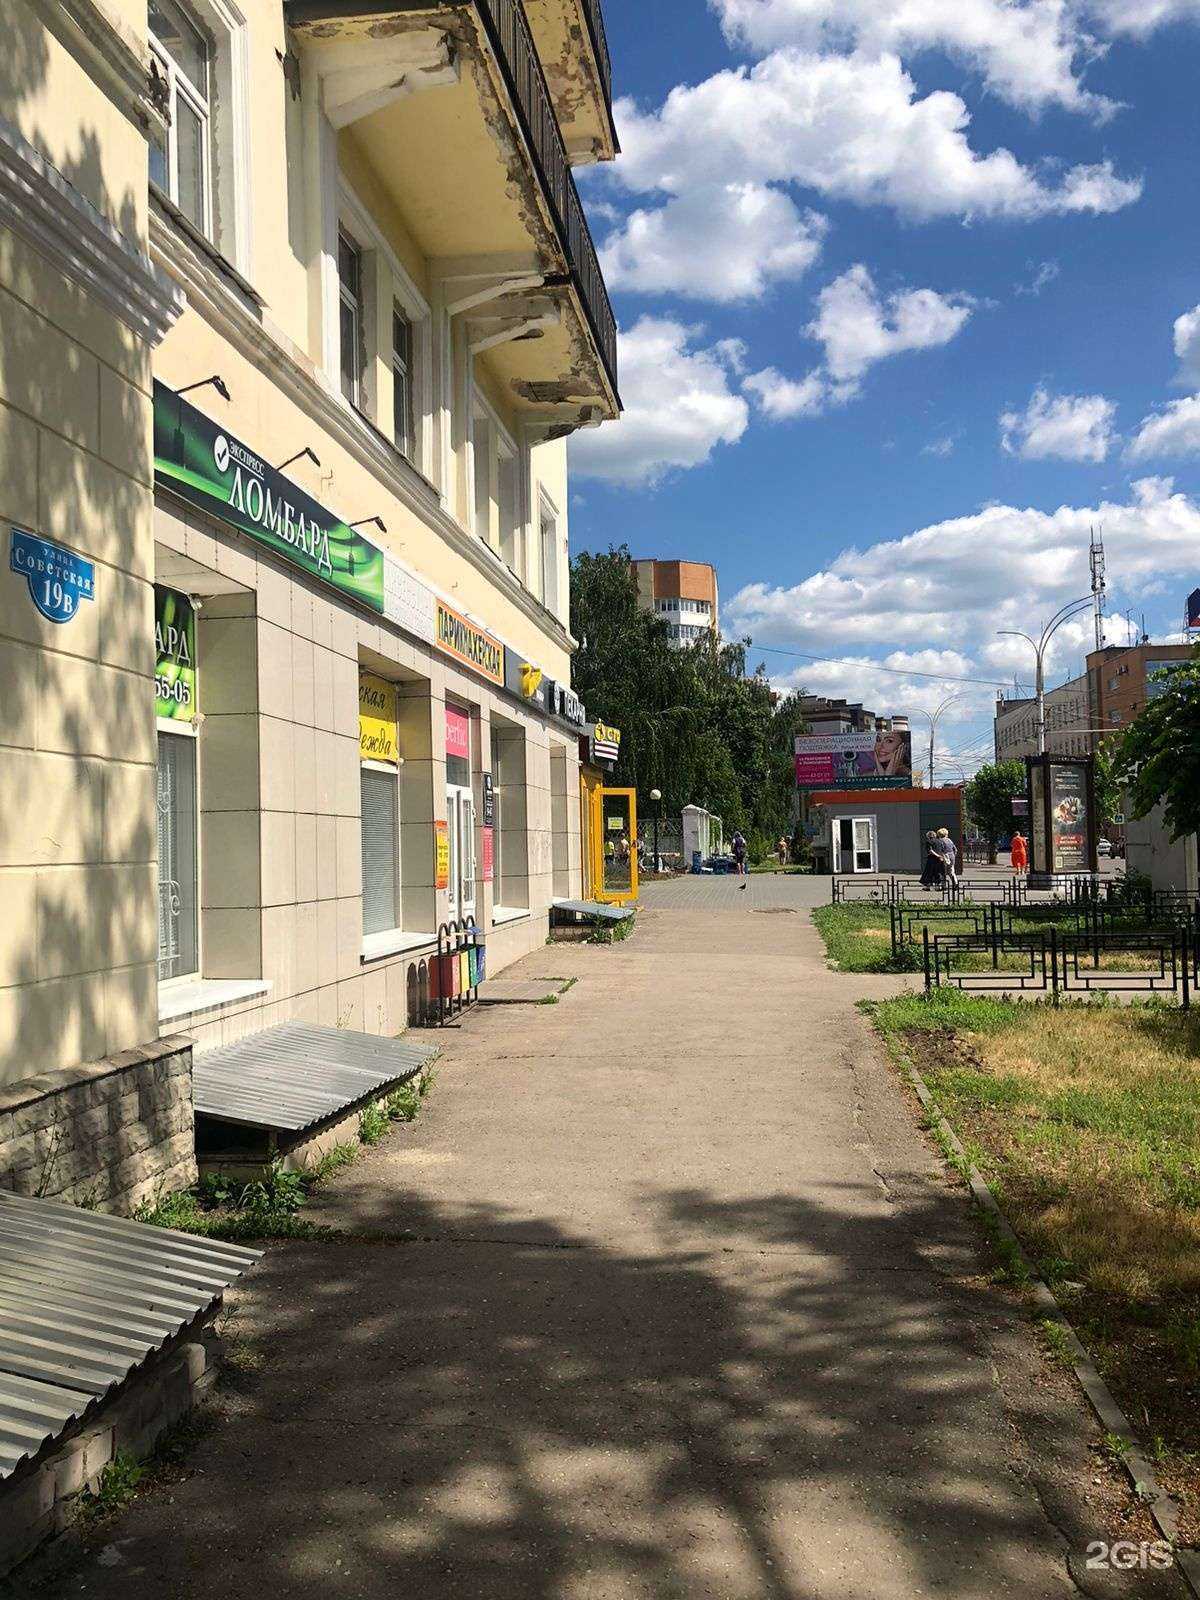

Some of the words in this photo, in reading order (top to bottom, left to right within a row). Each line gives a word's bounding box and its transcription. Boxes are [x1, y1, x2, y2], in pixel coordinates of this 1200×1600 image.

[229, 441, 265, 477] ЭКСПРЕСС
[227, 466, 333, 577] ЛОМБАРД
[15, 547, 91, 591] Советская
[360, 721, 391, 756] ежда
